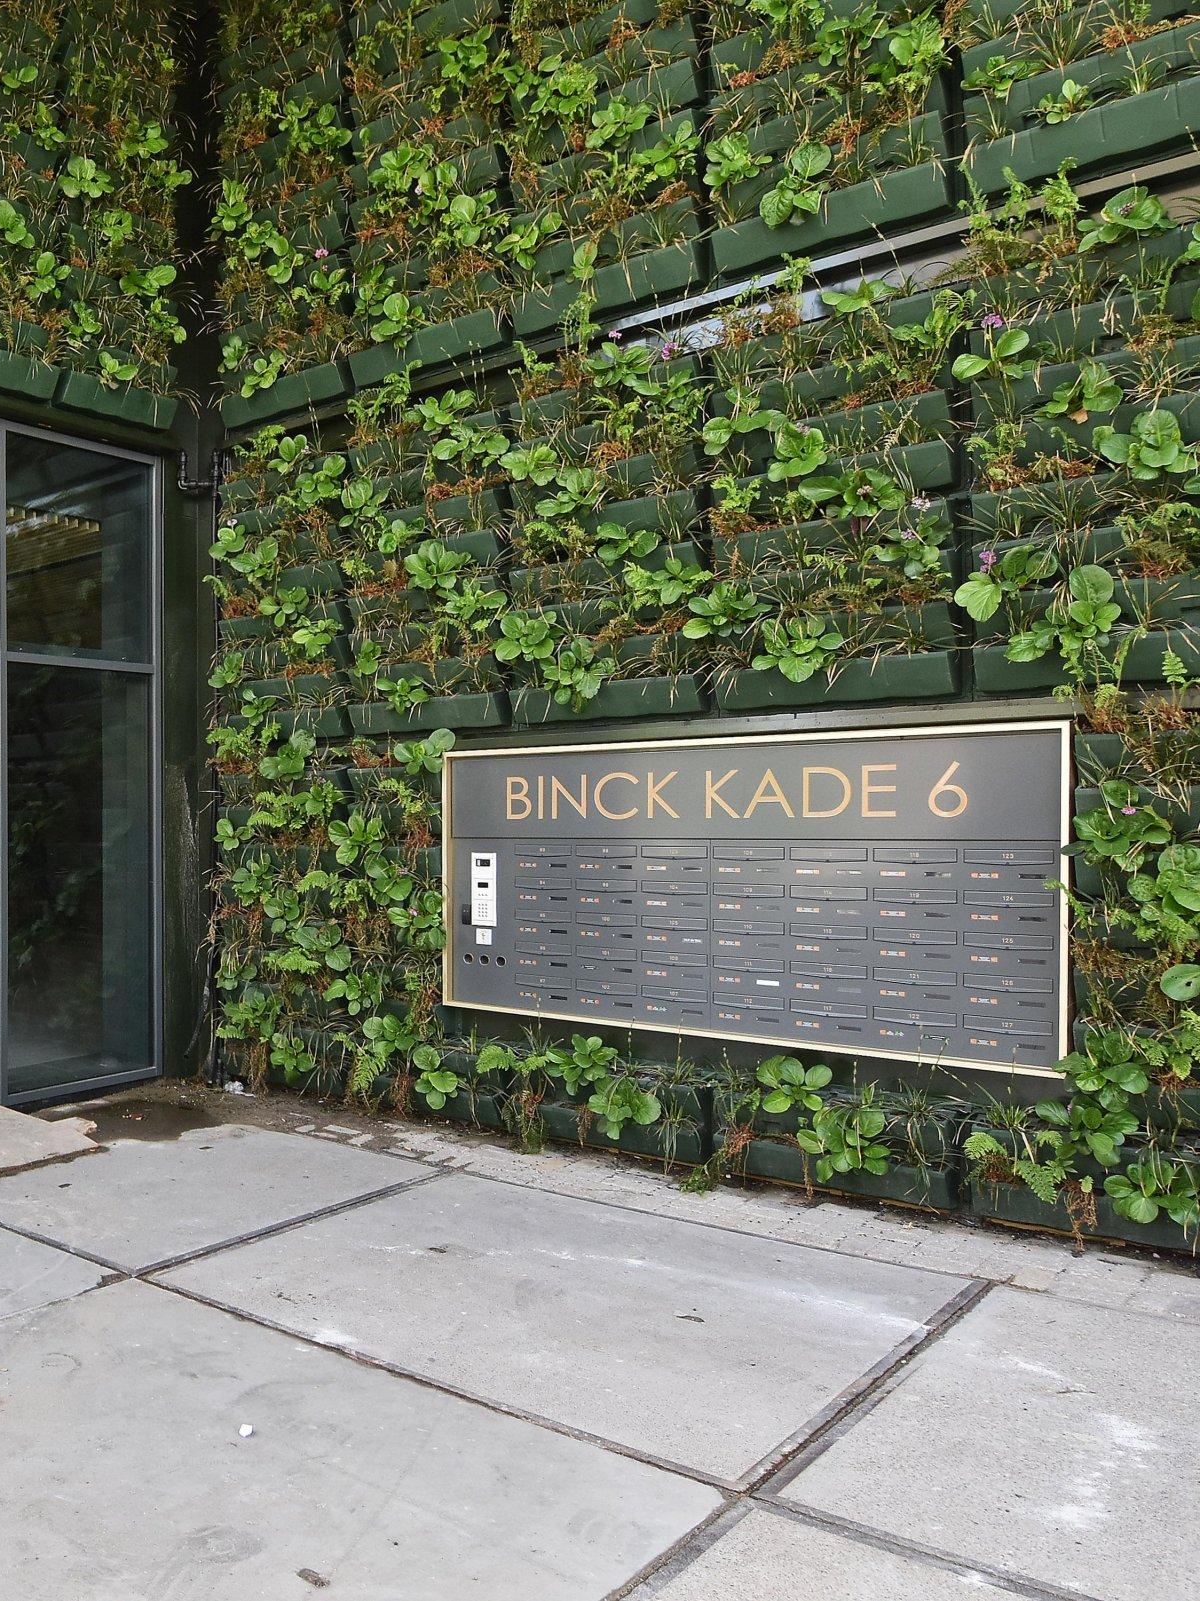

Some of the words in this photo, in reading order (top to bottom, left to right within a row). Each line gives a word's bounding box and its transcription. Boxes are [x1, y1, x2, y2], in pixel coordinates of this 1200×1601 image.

[506, 771, 680, 820] BINCK
[705, 764, 897, 819] KADE
[928, 761, 968, 818] 6
